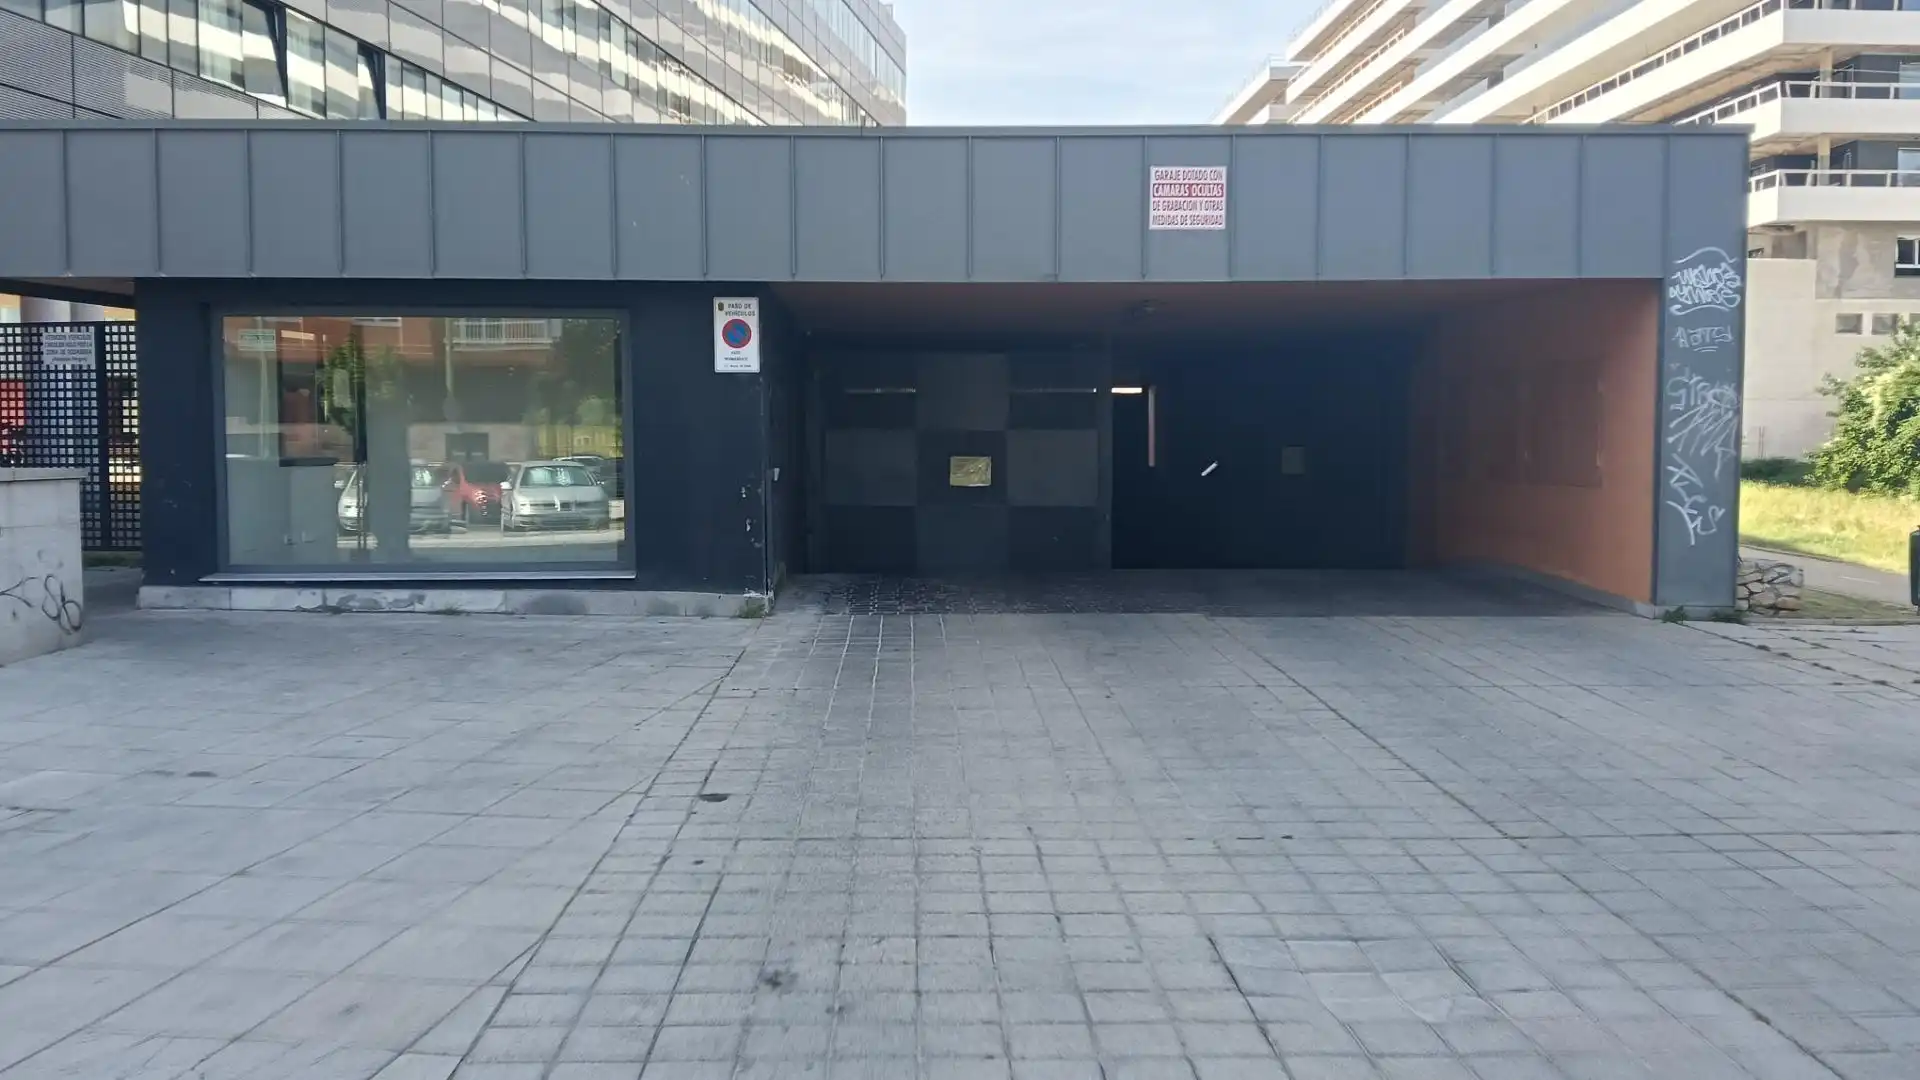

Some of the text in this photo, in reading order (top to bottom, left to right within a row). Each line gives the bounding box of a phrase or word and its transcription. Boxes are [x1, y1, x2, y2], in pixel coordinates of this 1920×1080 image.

[1154, 169, 1223, 181] GARAJE DOTADO CON
[1153, 184, 1223, 197] CAMARAS OCULTAS
[1152, 200, 1224, 211] DE GRABACION Y OTRAS
[1151, 214, 1224, 226] MEDIDAS DE SEGURIDAD
